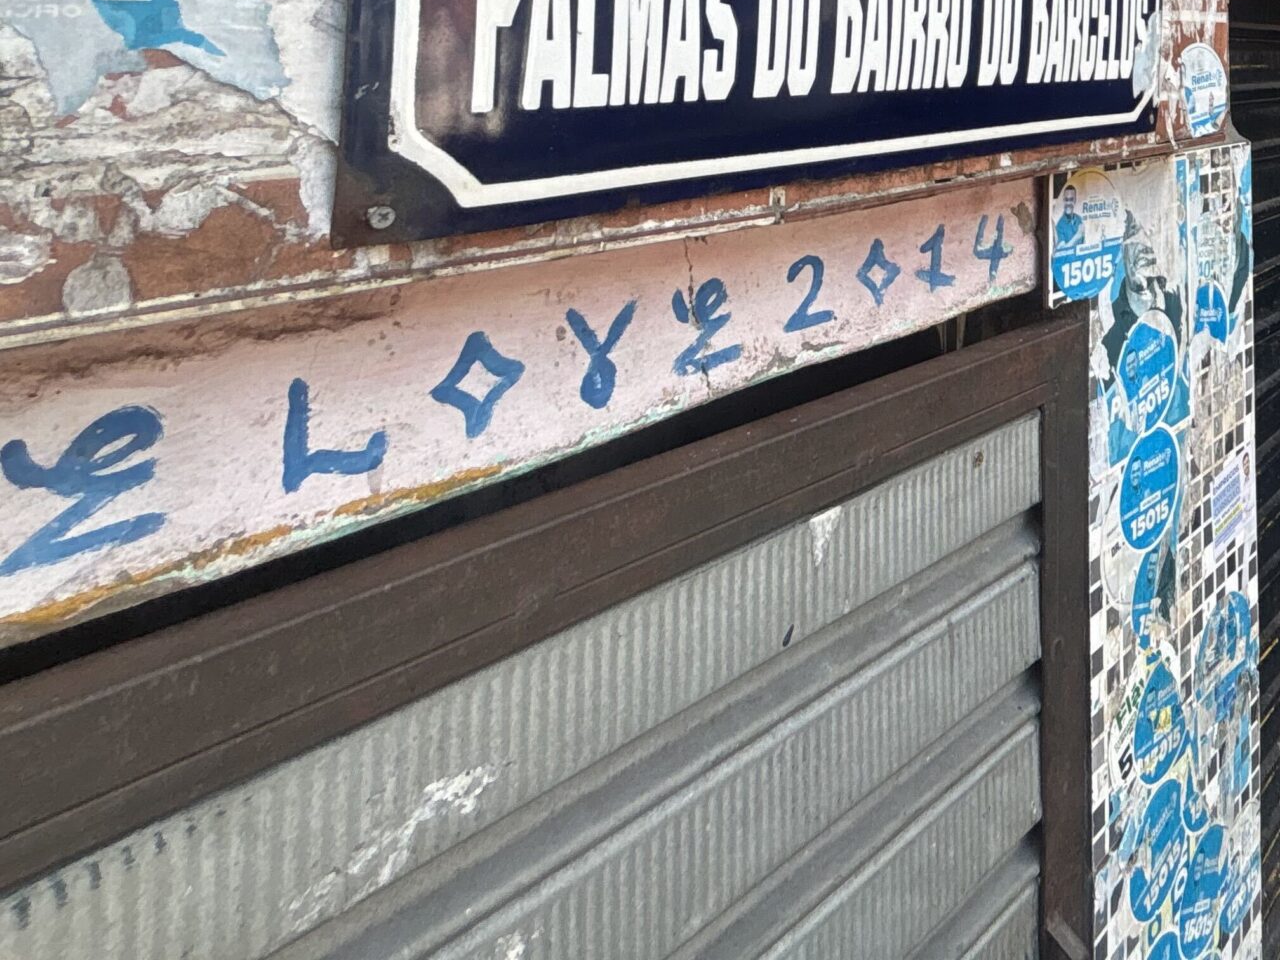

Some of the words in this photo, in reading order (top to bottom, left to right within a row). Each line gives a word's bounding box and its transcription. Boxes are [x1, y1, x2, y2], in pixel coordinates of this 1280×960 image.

[783, 215, 1013, 333] 2014
[1061, 254, 1113, 290] 15015
[1131, 497, 1170, 541] 15015
